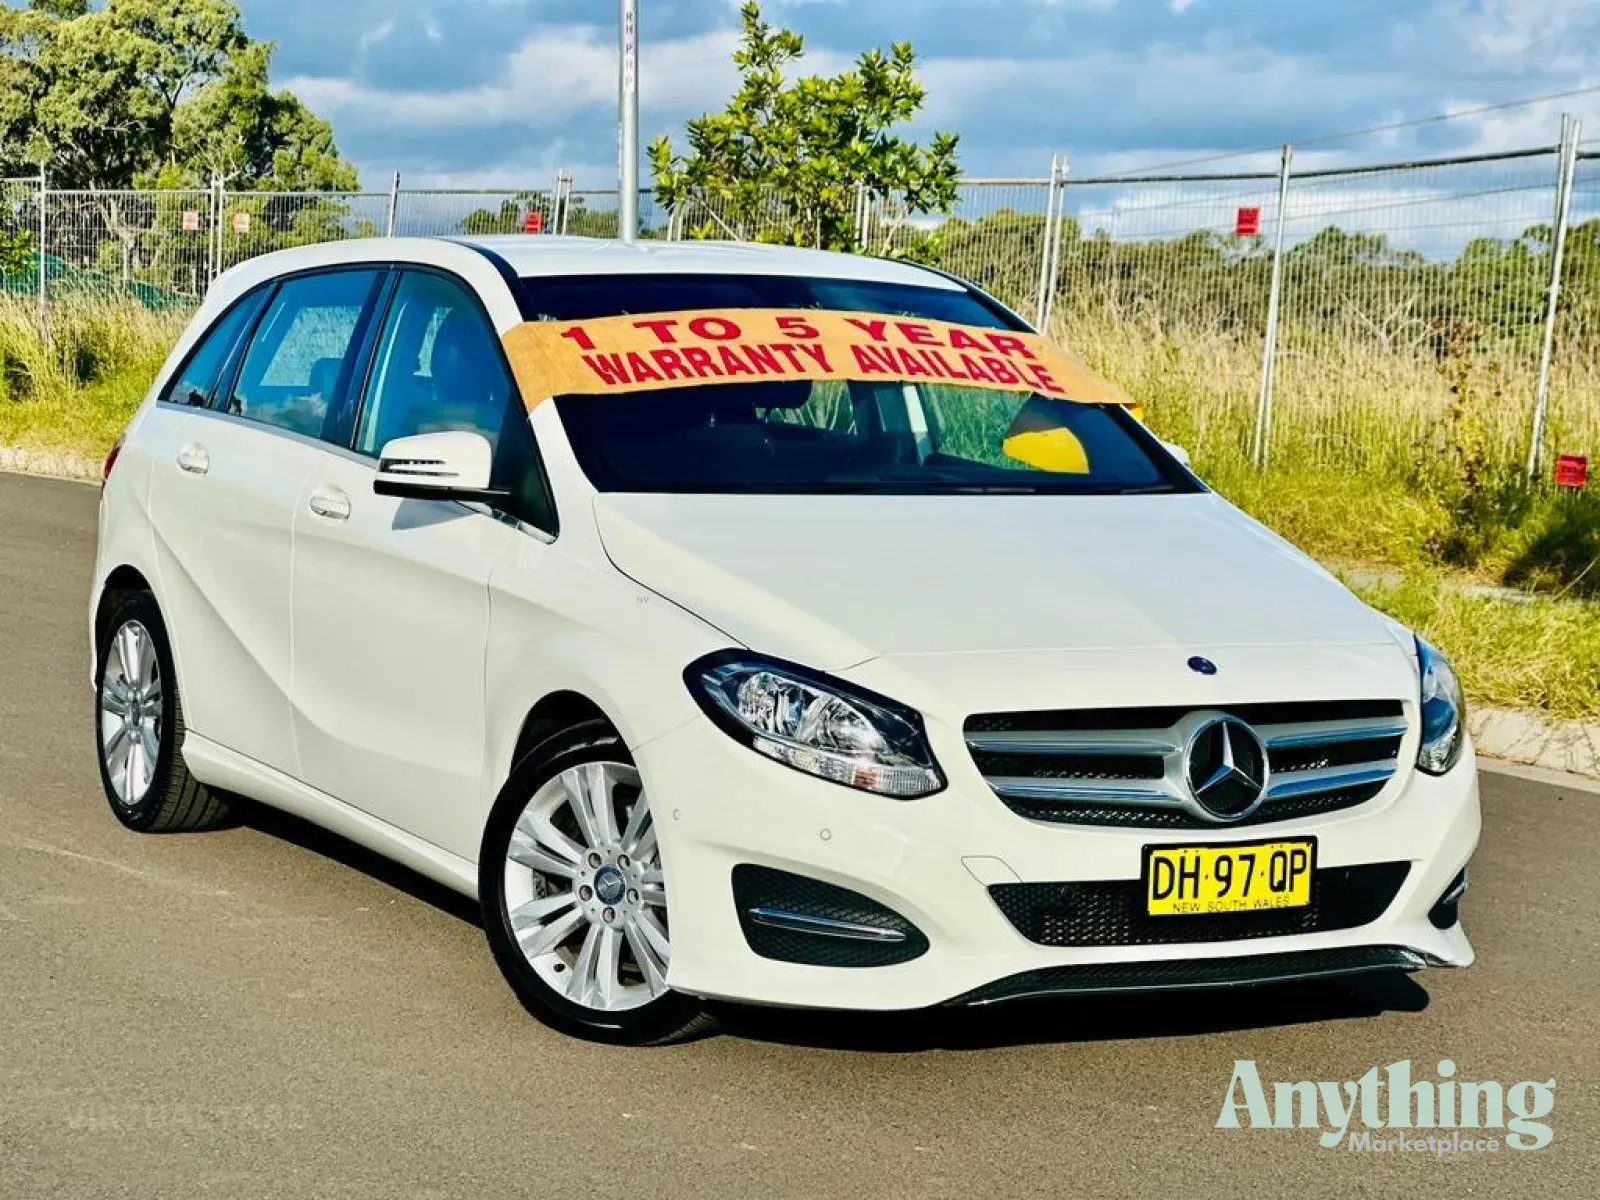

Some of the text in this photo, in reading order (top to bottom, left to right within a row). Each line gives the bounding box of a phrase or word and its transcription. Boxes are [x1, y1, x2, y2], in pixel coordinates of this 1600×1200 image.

[560, 316, 1036, 360] 1 TO 5 YEAR
[581, 343, 1065, 394] WARRANTY AVAILABLE
[1173, 896, 1290, 913] NEW SOUTH WALES
